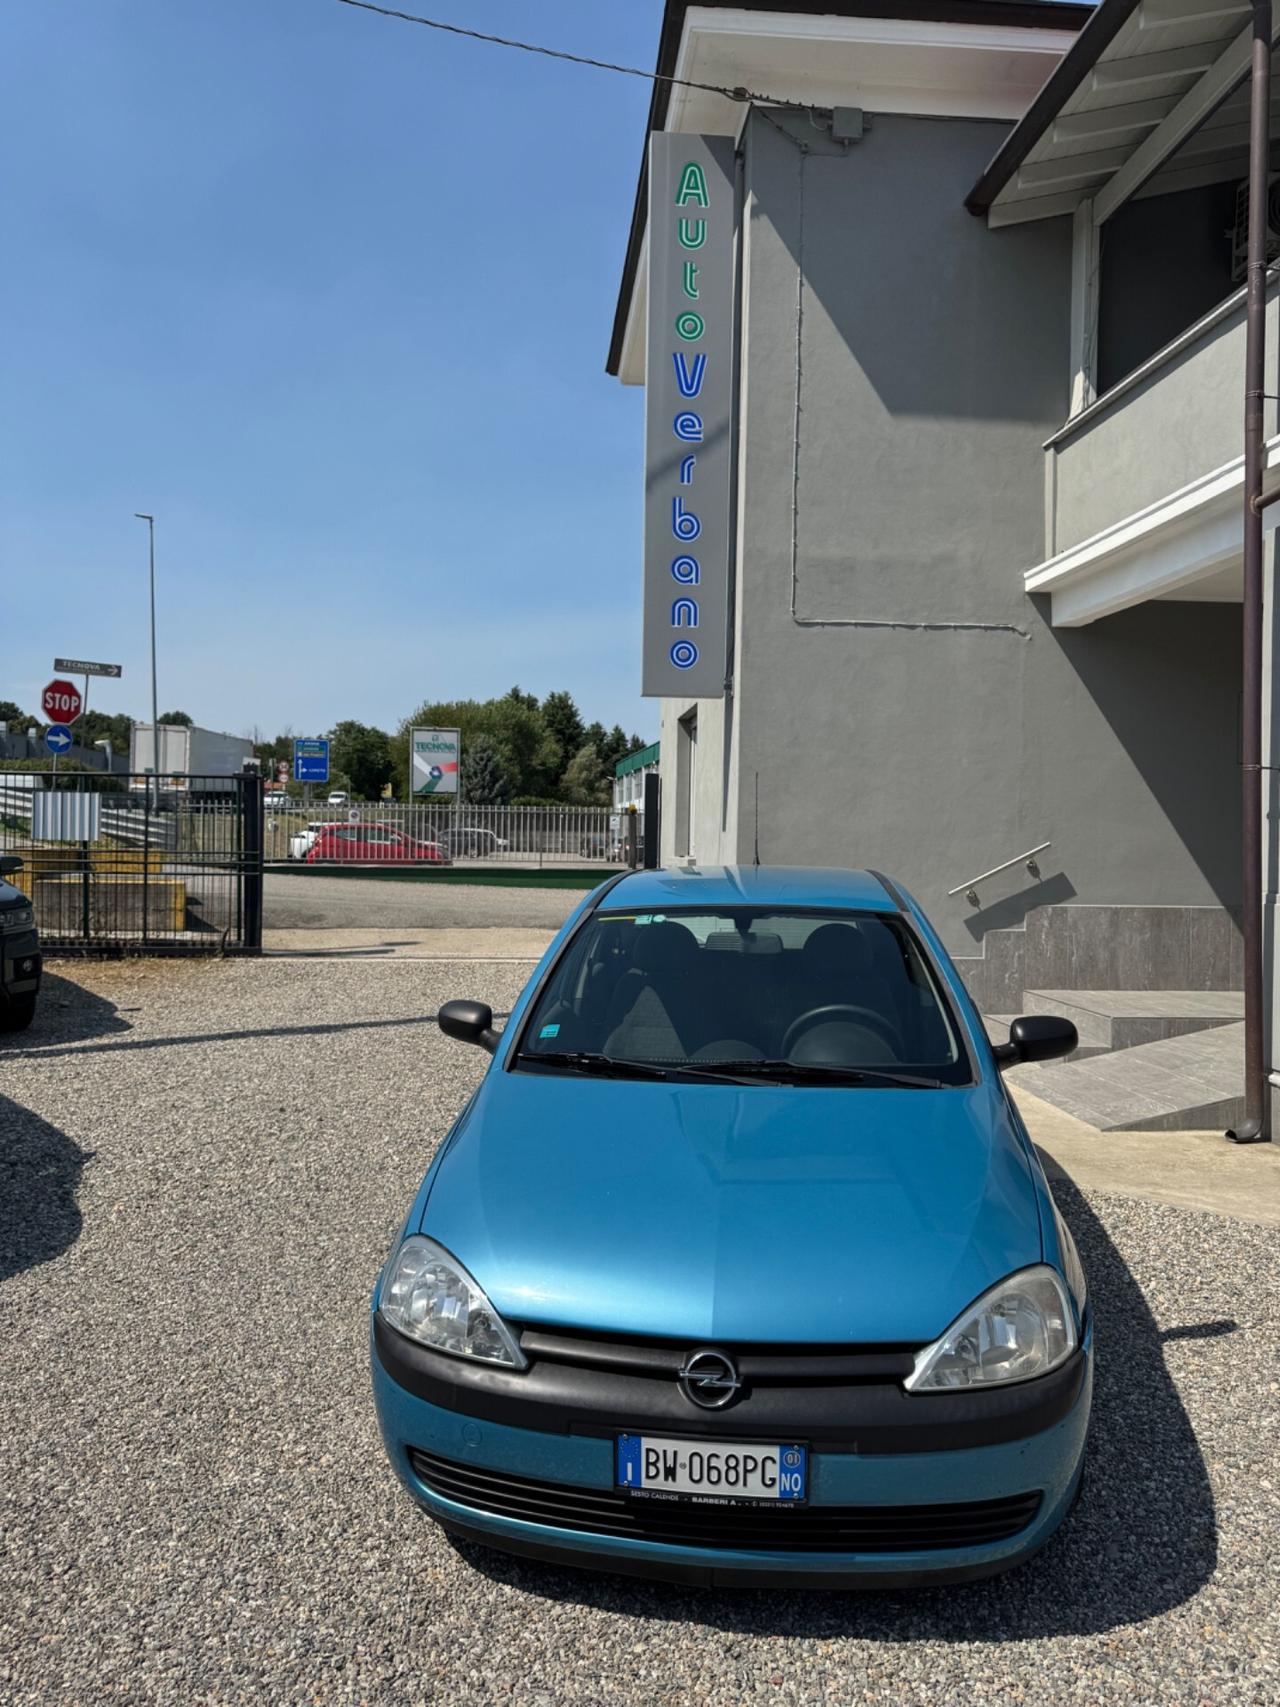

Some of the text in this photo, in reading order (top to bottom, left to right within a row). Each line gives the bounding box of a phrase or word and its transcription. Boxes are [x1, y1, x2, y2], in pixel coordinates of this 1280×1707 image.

[45, 692, 79, 712] STOP
[415, 741, 456, 751] TECNOVA
[780, 1473, 801, 1492] NO
